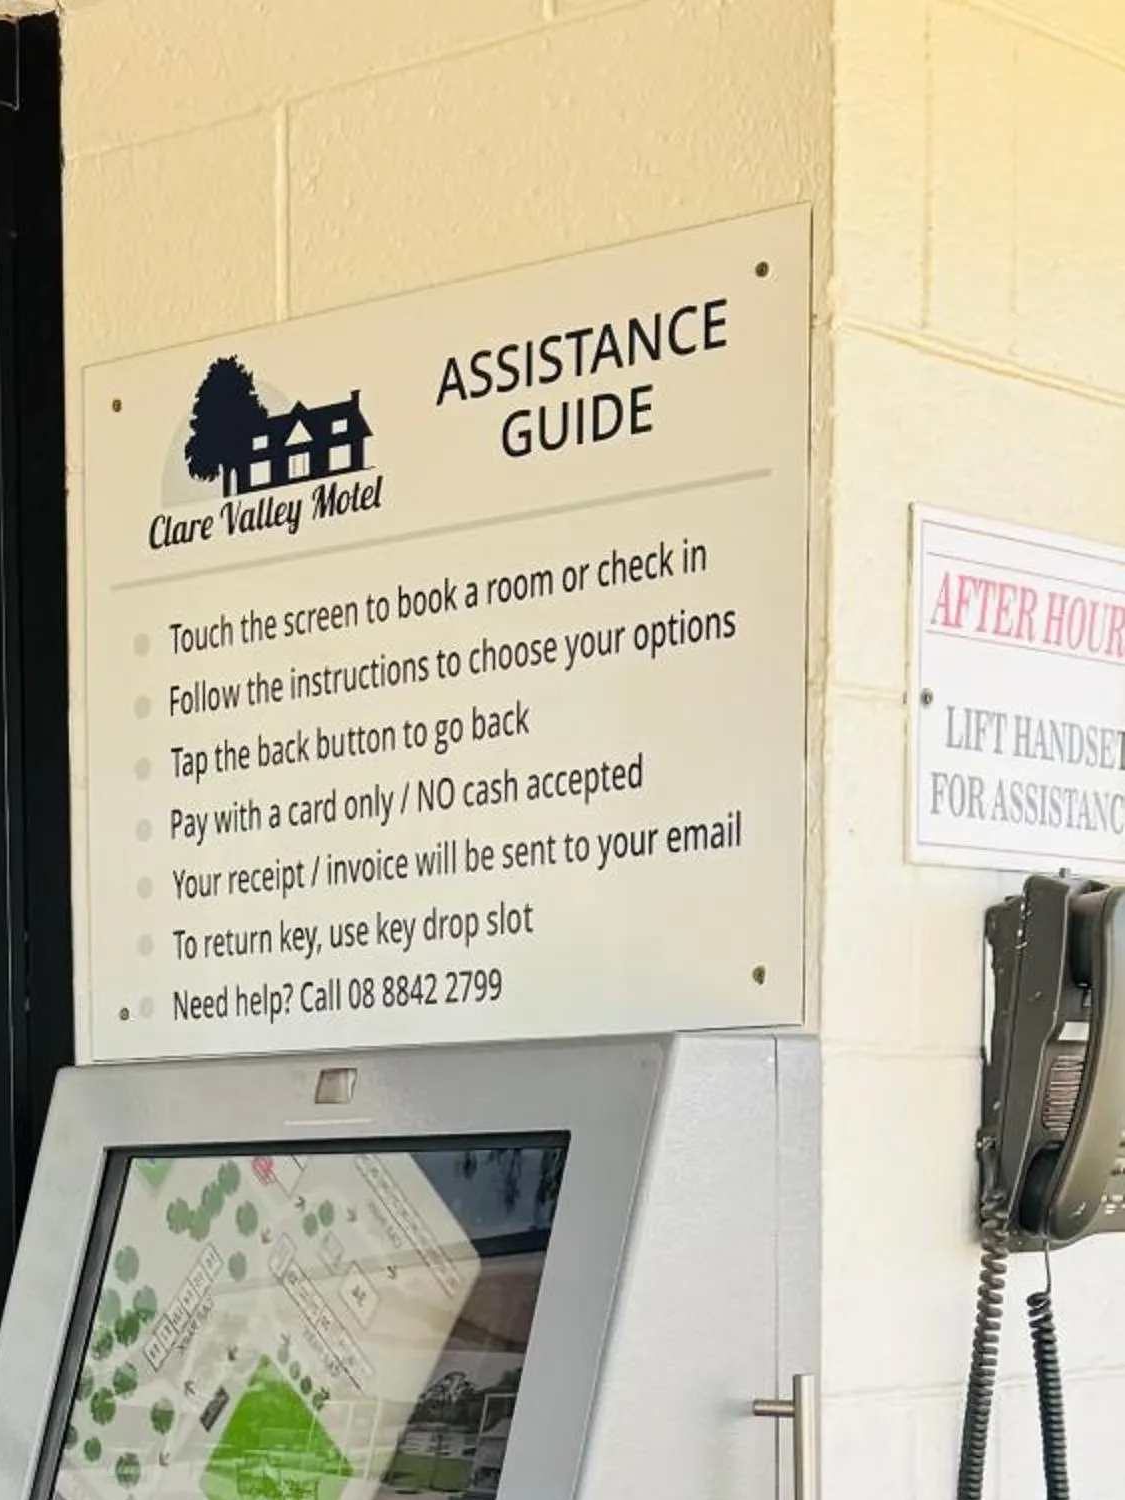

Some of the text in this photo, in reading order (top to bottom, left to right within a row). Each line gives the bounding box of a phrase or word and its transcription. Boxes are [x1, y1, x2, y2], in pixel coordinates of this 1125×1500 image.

[437, 299, 727, 406] ASSISTANCE
[502, 384, 653, 457] GUIDE
[149, 476, 383, 549] Clare Valley Motel
[169, 538, 706, 654] Touch the screen to book a room or check in
[171, 610, 735, 716] Follow the instructions to choose your options
[171, 702, 529, 784] Tap the back button to go back
[171, 752, 642, 846] Pay with a card only NO cash accepted
[173, 810, 741, 899] Your receipt invoice will be sent to your email
[173, 901, 533, 960] To return key, use key drop slot
[174, 968, 501, 1023] Need help? Call 08 8842 2799
